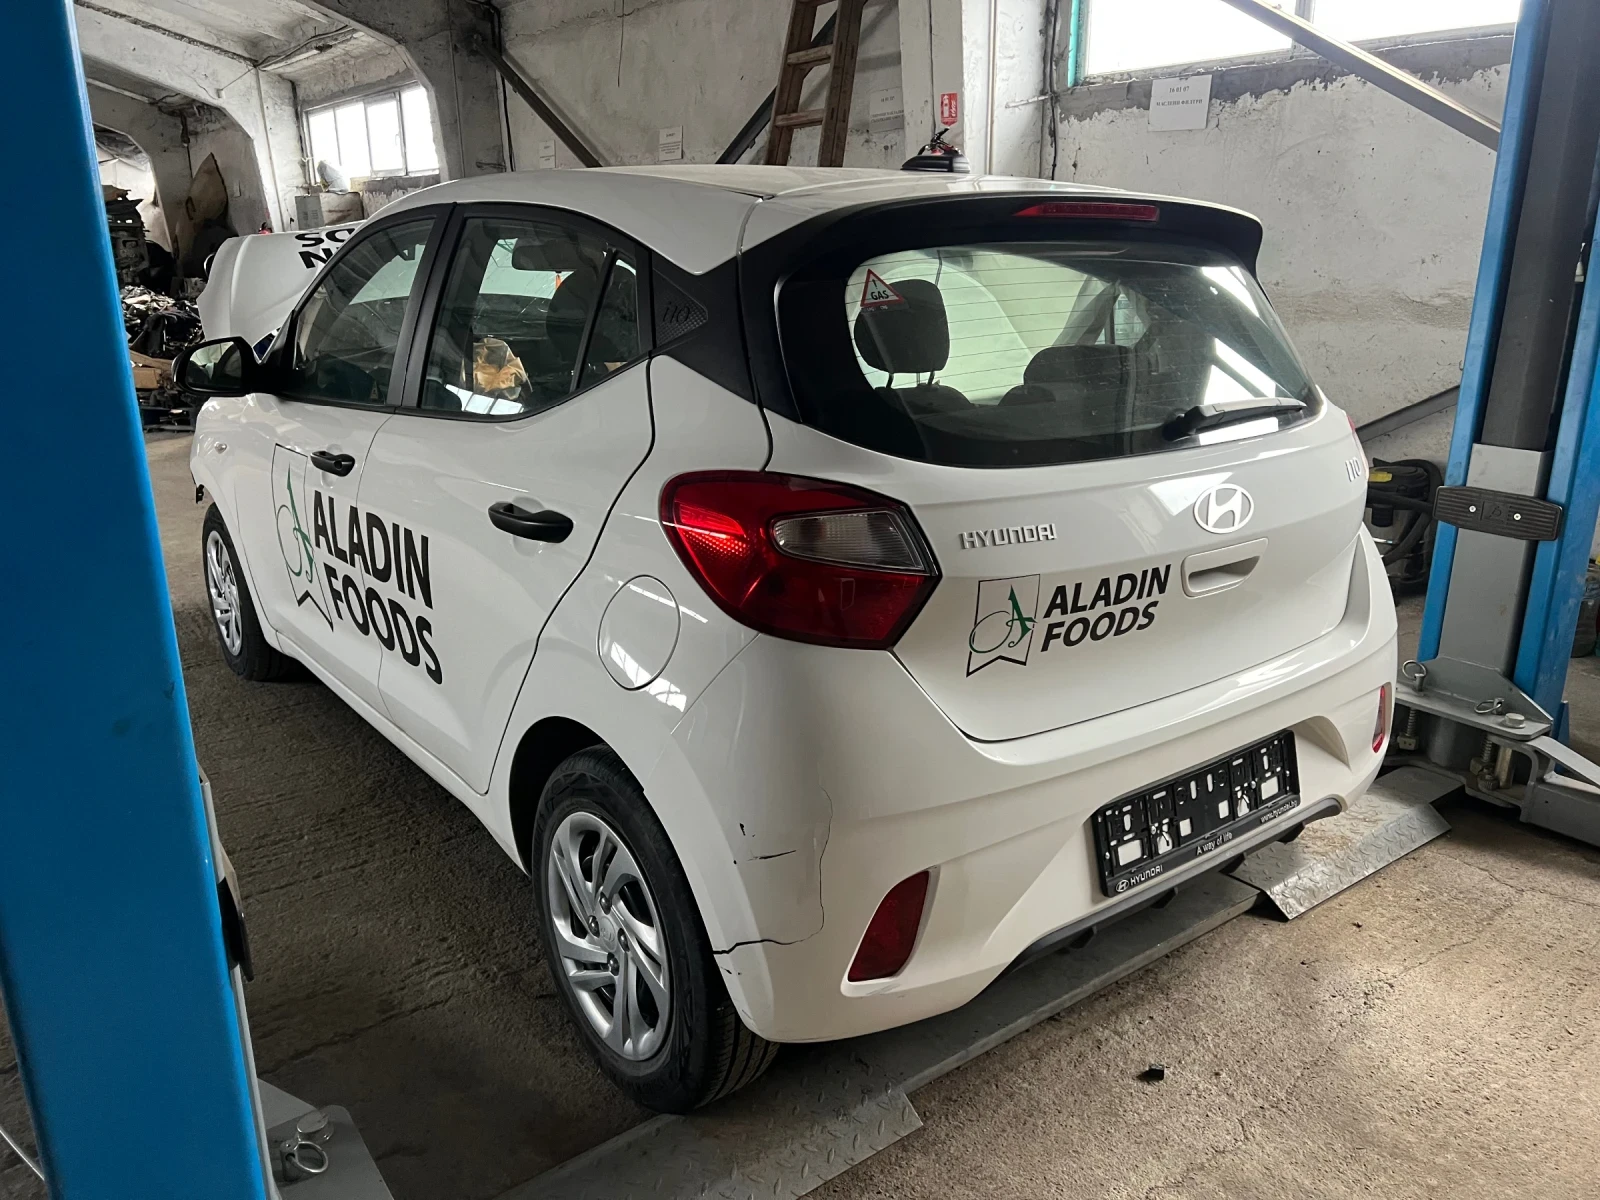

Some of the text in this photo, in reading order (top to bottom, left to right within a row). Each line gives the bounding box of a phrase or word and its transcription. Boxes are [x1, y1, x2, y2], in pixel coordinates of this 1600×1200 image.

[871, 290, 889, 300] GAS
[313, 490, 434, 610] ALADIN
[959, 523, 1058, 549] HYUNDAI
[1042, 564, 1172, 619] ALADIN
[323, 561, 443, 685] FOODS
[1040, 601, 1160, 652] FOODS
[1196, 832, 1233, 856] A way of life
[1130, 864, 1164, 886] HYUNDAI
